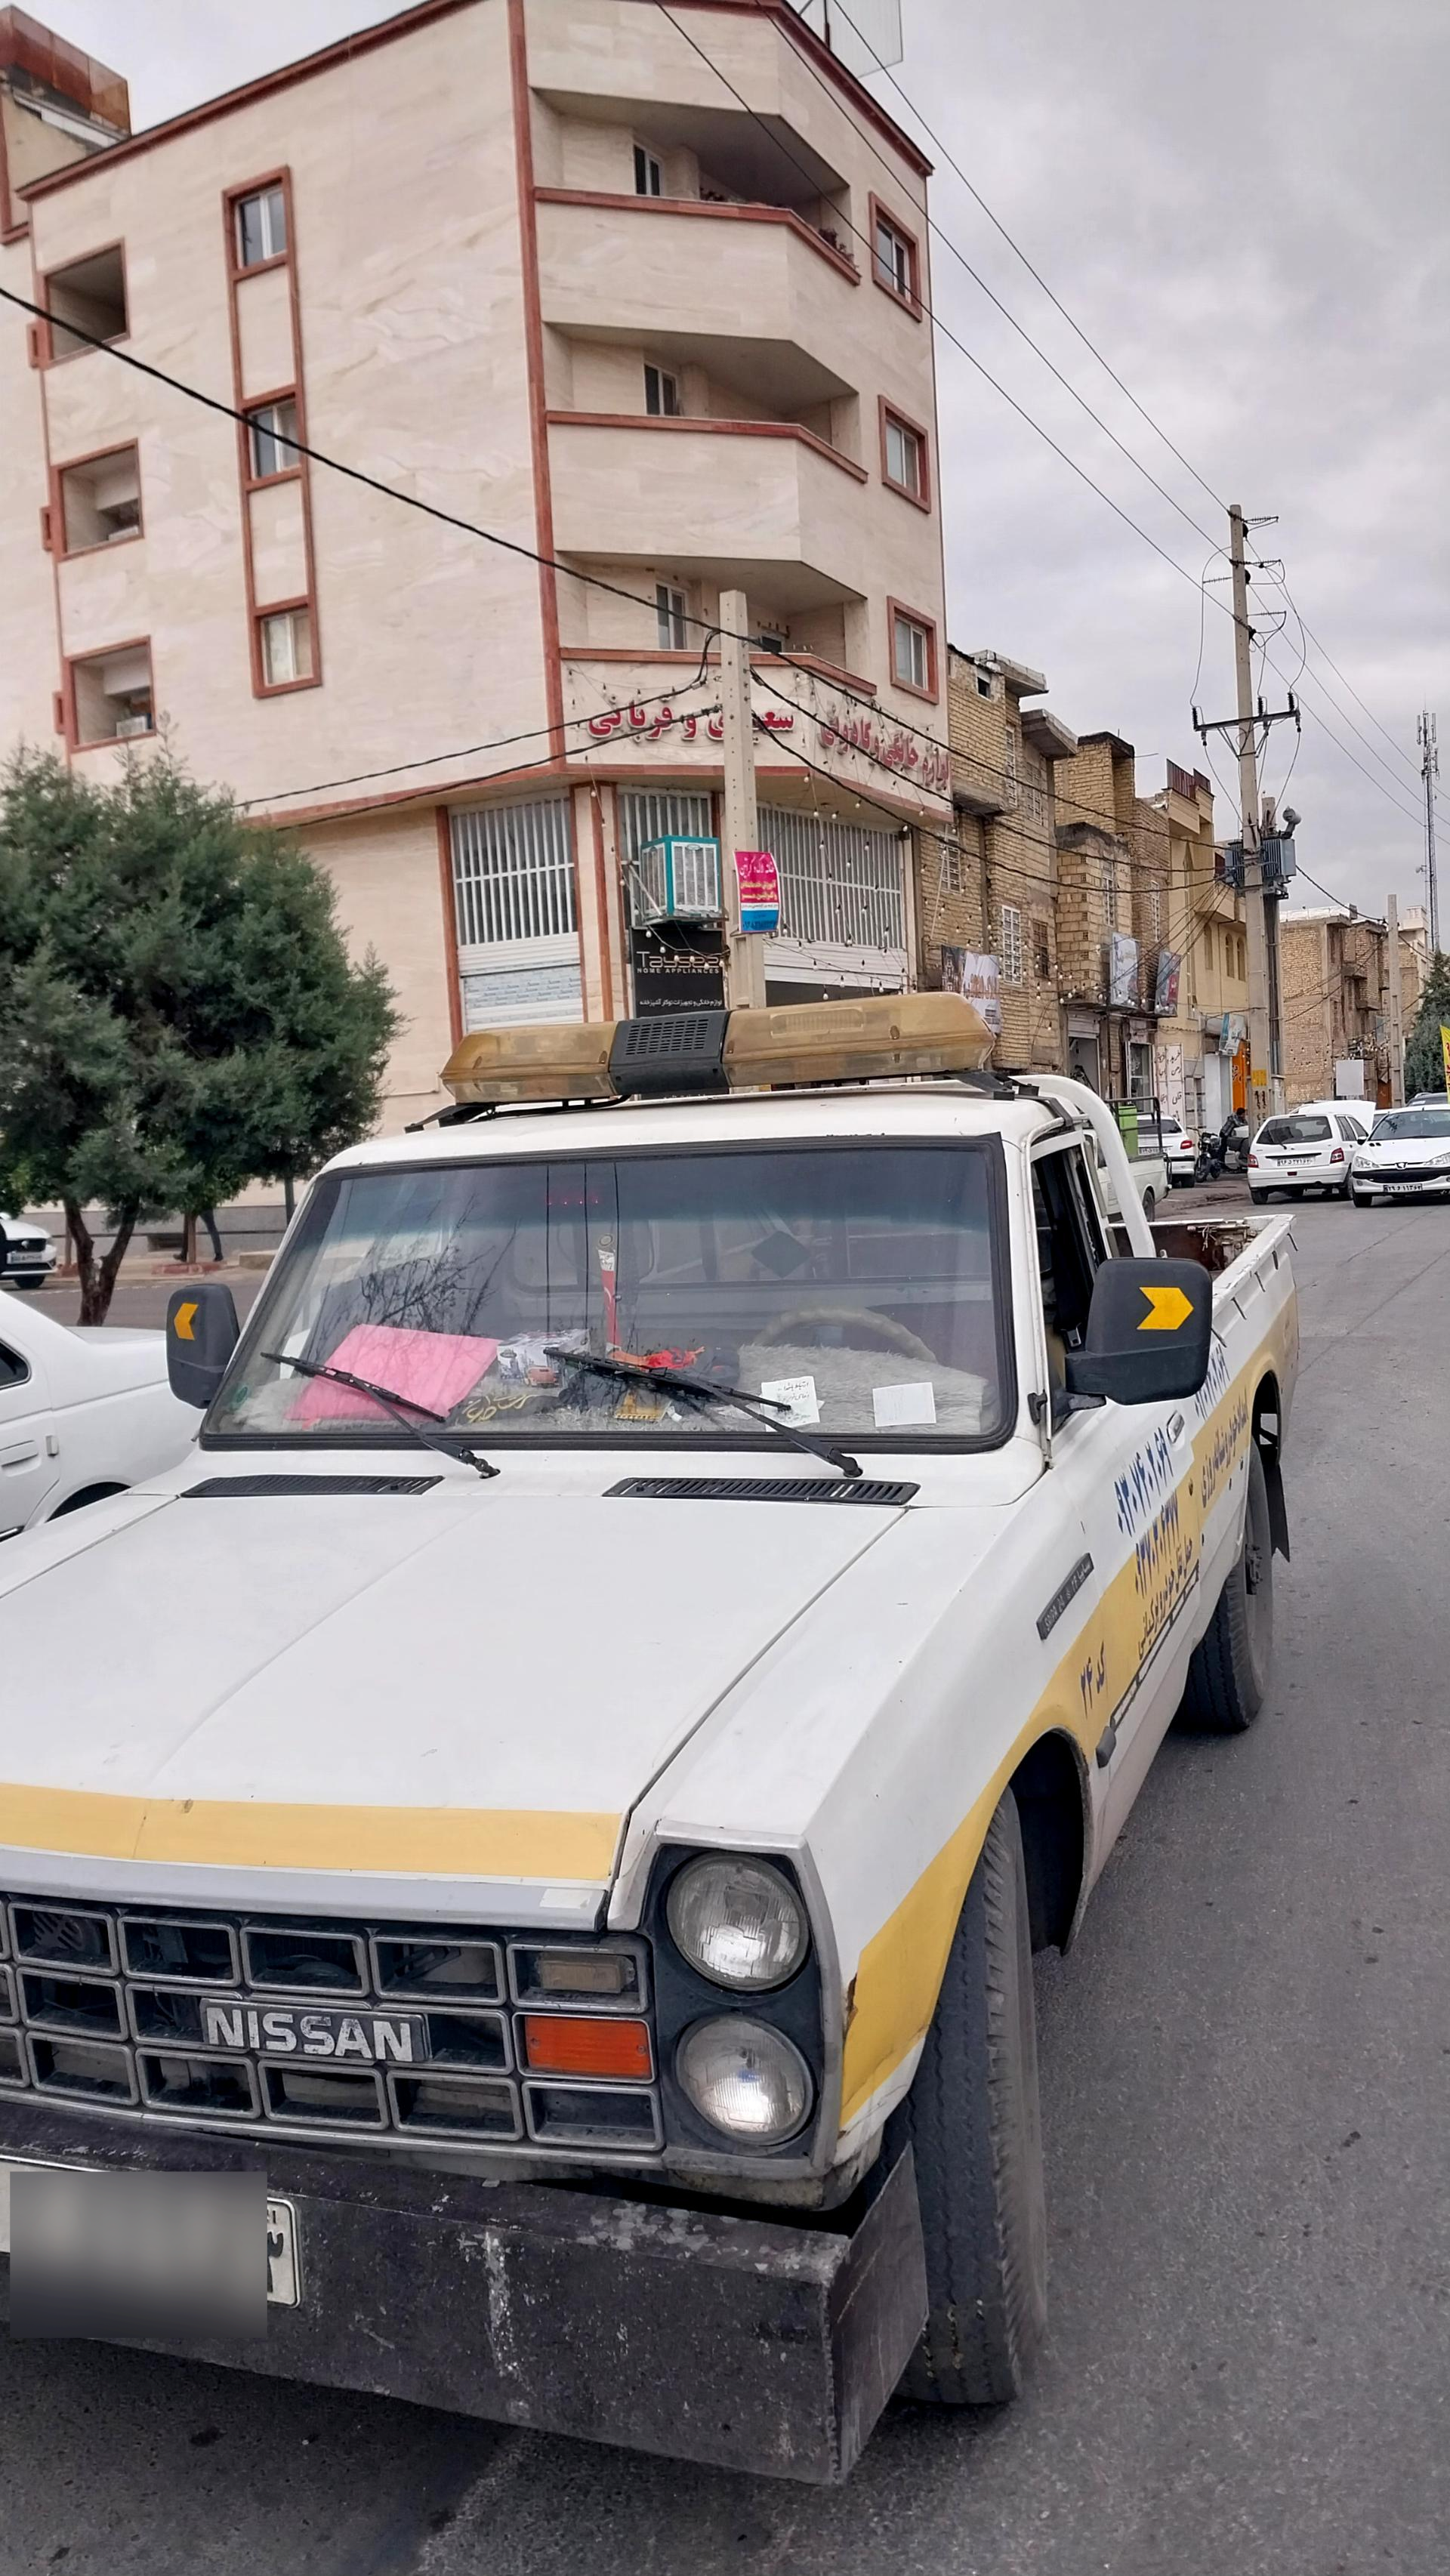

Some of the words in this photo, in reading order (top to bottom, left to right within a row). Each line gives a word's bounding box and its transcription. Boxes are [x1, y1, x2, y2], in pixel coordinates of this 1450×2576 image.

[588, 696, 674, 742] قربانی
[682, 716, 698, 741] و
[708, 711, 794, 742] سعیی
[205, 2006, 413, 2062] NISSAN
